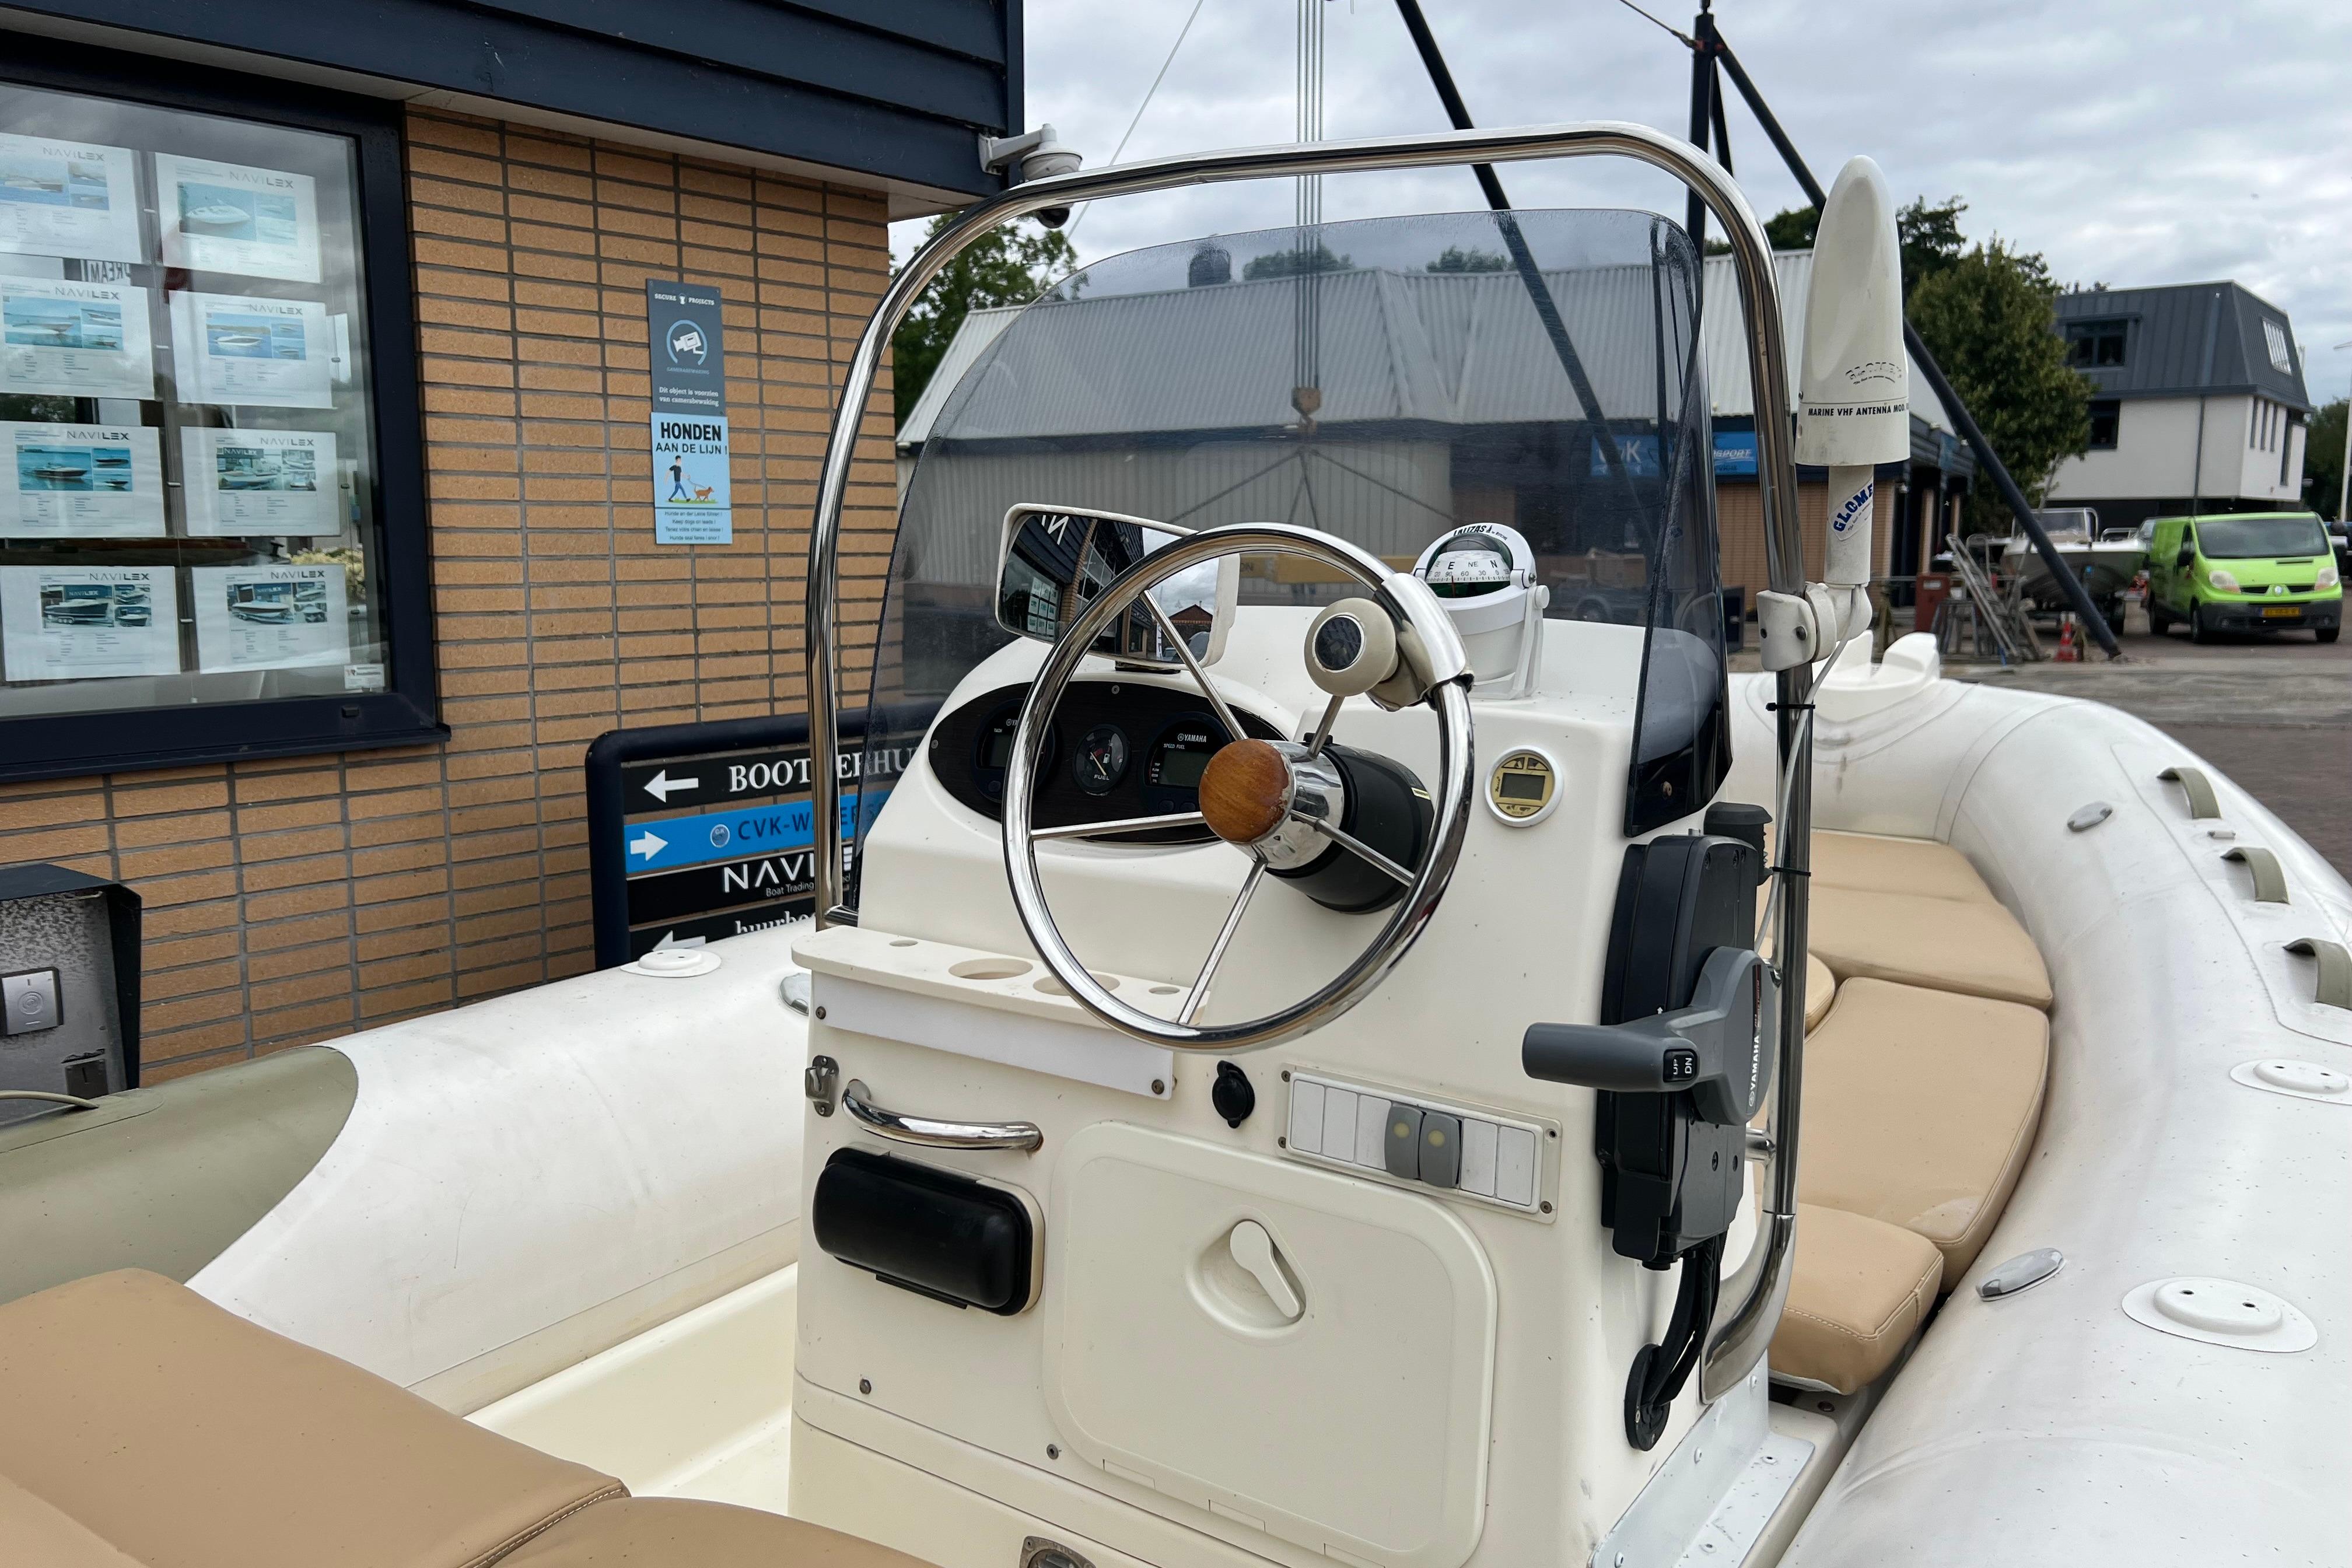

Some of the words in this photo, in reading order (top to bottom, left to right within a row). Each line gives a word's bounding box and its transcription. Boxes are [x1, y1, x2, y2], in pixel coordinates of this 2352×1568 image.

[43, 146, 104, 161] NAVILEX
[230, 171, 294, 189] NAVILEX
[55, 286, 120, 300] NAVILEX
[249, 303, 303, 315] NAVILEX
[669, 387, 687, 396] object
[1808, 408, 1834, 416] MARINE
[1838, 408, 1853, 416] VHF
[1856, 406, 1891, 415] ANTENNA
[66, 430, 130, 440] NAVILEX
[660, 422, 722, 442] HONDEN
[261, 438, 314, 446] NAVILEX
[656, 442, 678, 453] AAN
[682, 443, 696, 453] DE
[700, 444, 722, 454] LIJN
[1447, 561, 1455, 570] E
[1490, 559, 1498, 569] N
[270, 570, 325, 579] NAVILEX
[1184, 734, 1206, 742] YAMAHA
[766, 887, 784, 897] Boat
[785, 881, 814, 894] Trading
[1672, 1058, 1678, 1075] UP
[1684, 1058, 1693, 1074] DN
[1750, 1035, 1760, 1091] YAMAHA
